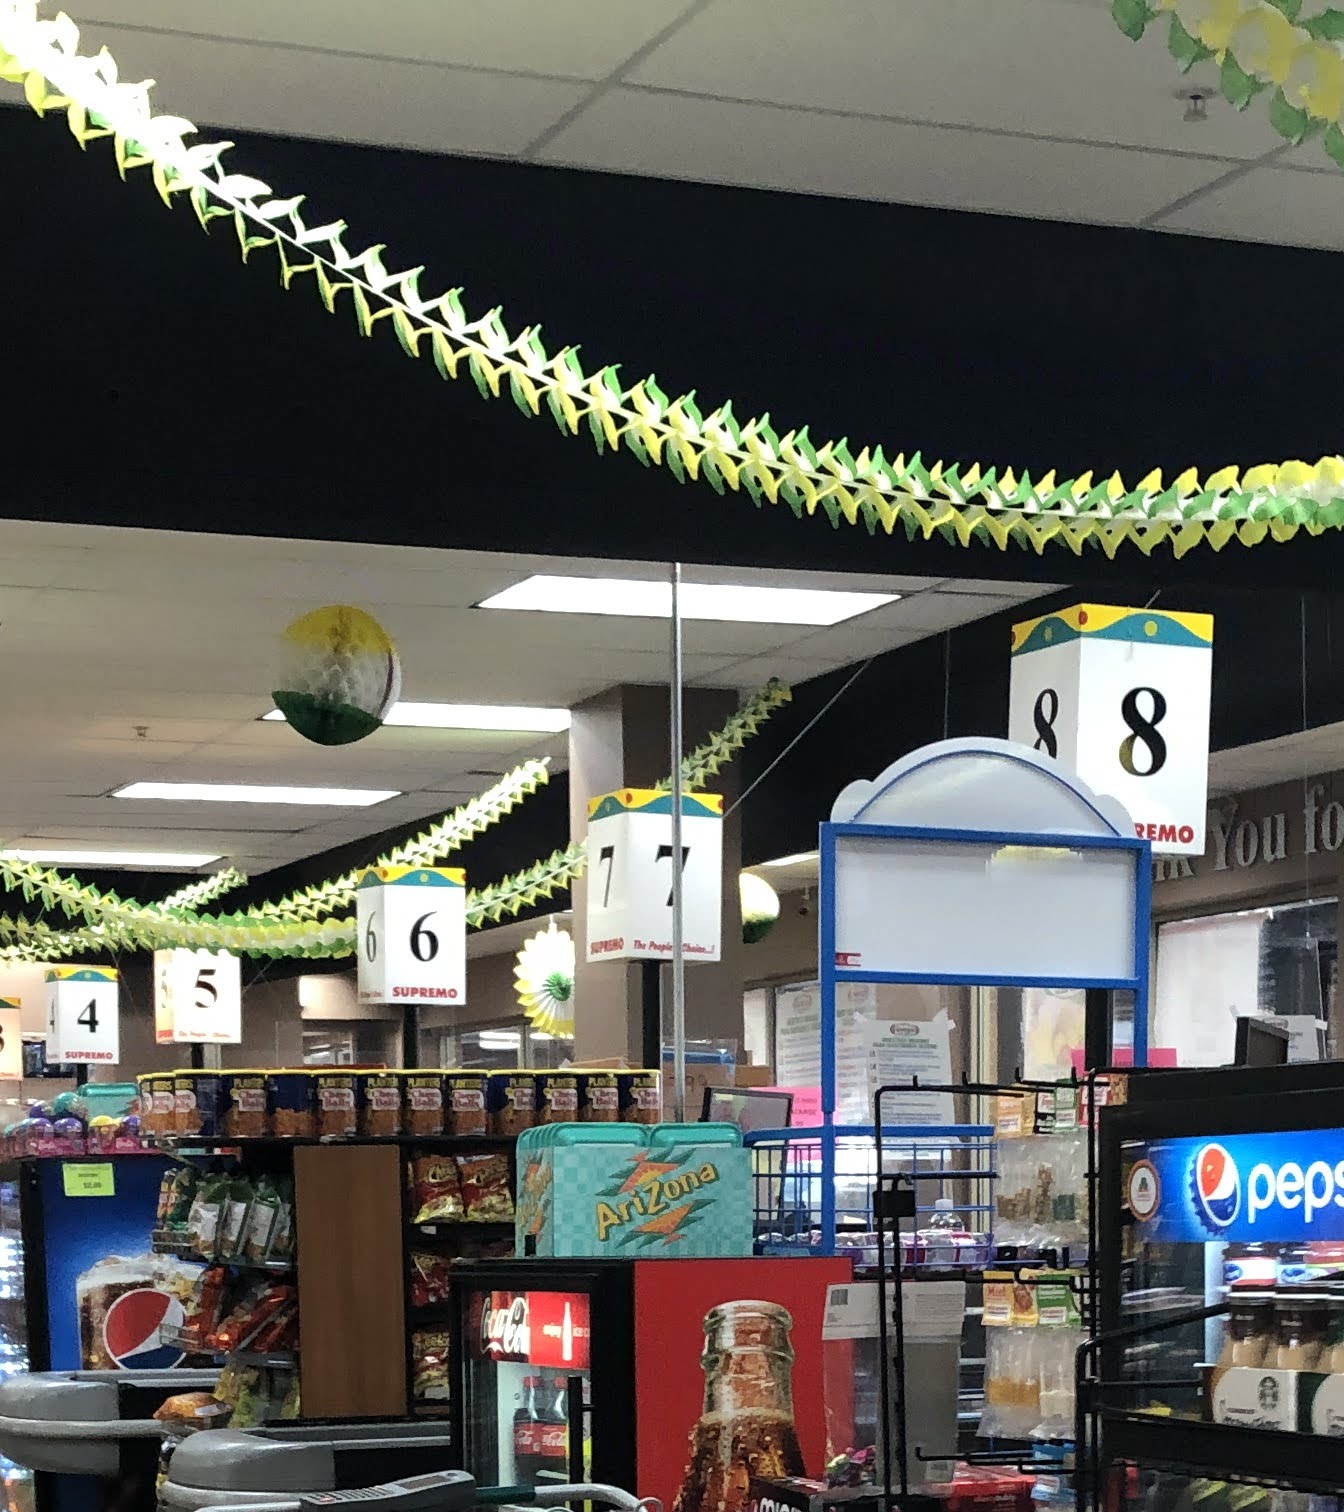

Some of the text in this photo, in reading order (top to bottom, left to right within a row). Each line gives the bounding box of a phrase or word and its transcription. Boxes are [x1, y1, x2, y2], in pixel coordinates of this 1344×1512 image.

[1034, 688, 1059, 760] 8
[1118, 686, 1167, 777] 8
[1134, 822, 1195, 845] REMO
[1207, 798, 1289, 872] You
[599, 844, 615, 908] 7
[655, 844, 691, 907] 7
[366, 911, 377, 963] 6
[409, 910, 439, 963] 6
[648, 940, 673, 952] People
[194, 968, 218, 1009] 5
[392, 986, 458, 999] SUPREMO
[77, 998, 99, 1033] 4
[64, 1051, 114, 1060] SUPREMO
[595, 1162, 720, 1242] AriZona
